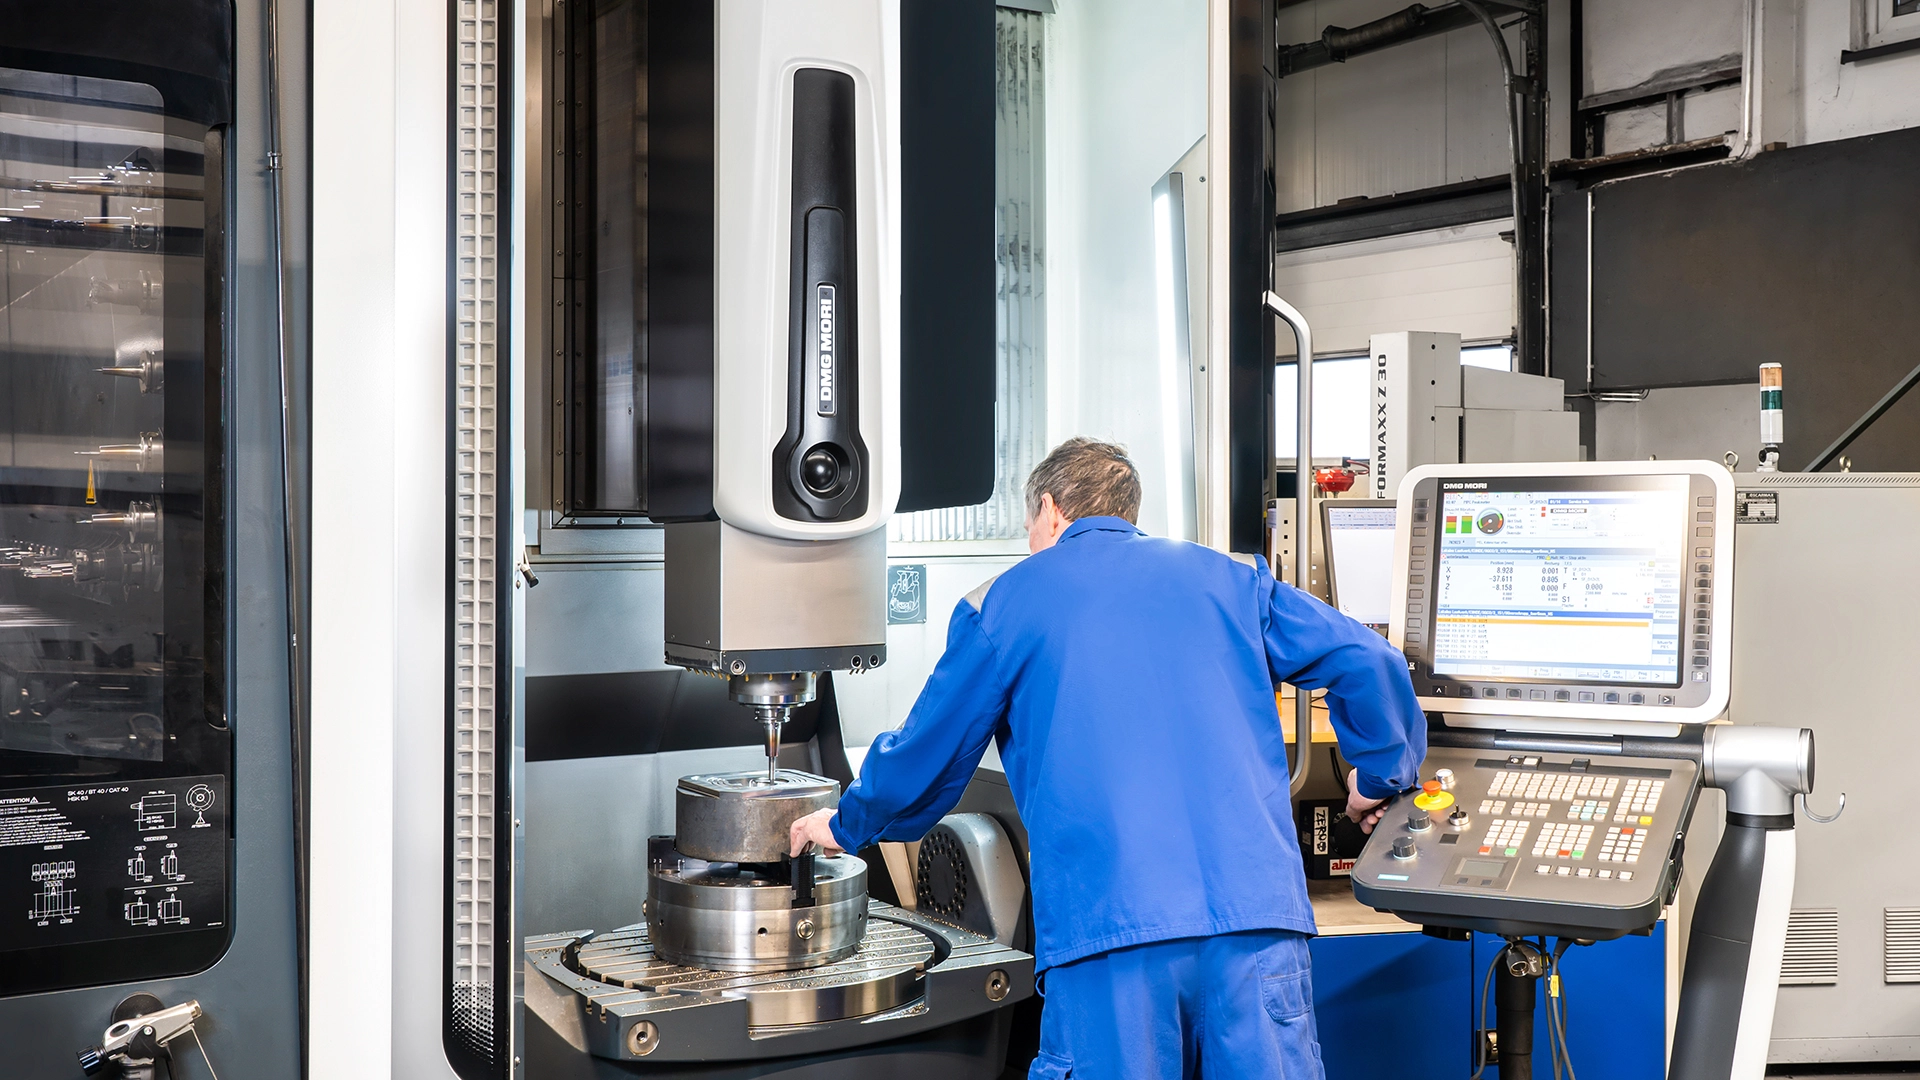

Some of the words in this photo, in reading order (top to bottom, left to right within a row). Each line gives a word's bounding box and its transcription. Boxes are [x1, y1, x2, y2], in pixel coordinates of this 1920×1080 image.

[821, 299, 832, 351] MORI
[821, 353, 832, 401] DMG
[1377, 354, 1386, 381] 30
[1378, 386, 1386, 397] Z
[1377, 403, 1386, 499] FORMAXX
[1314, 810, 1327, 841] ZERO
[1332, 859, 1354, 870] alm
